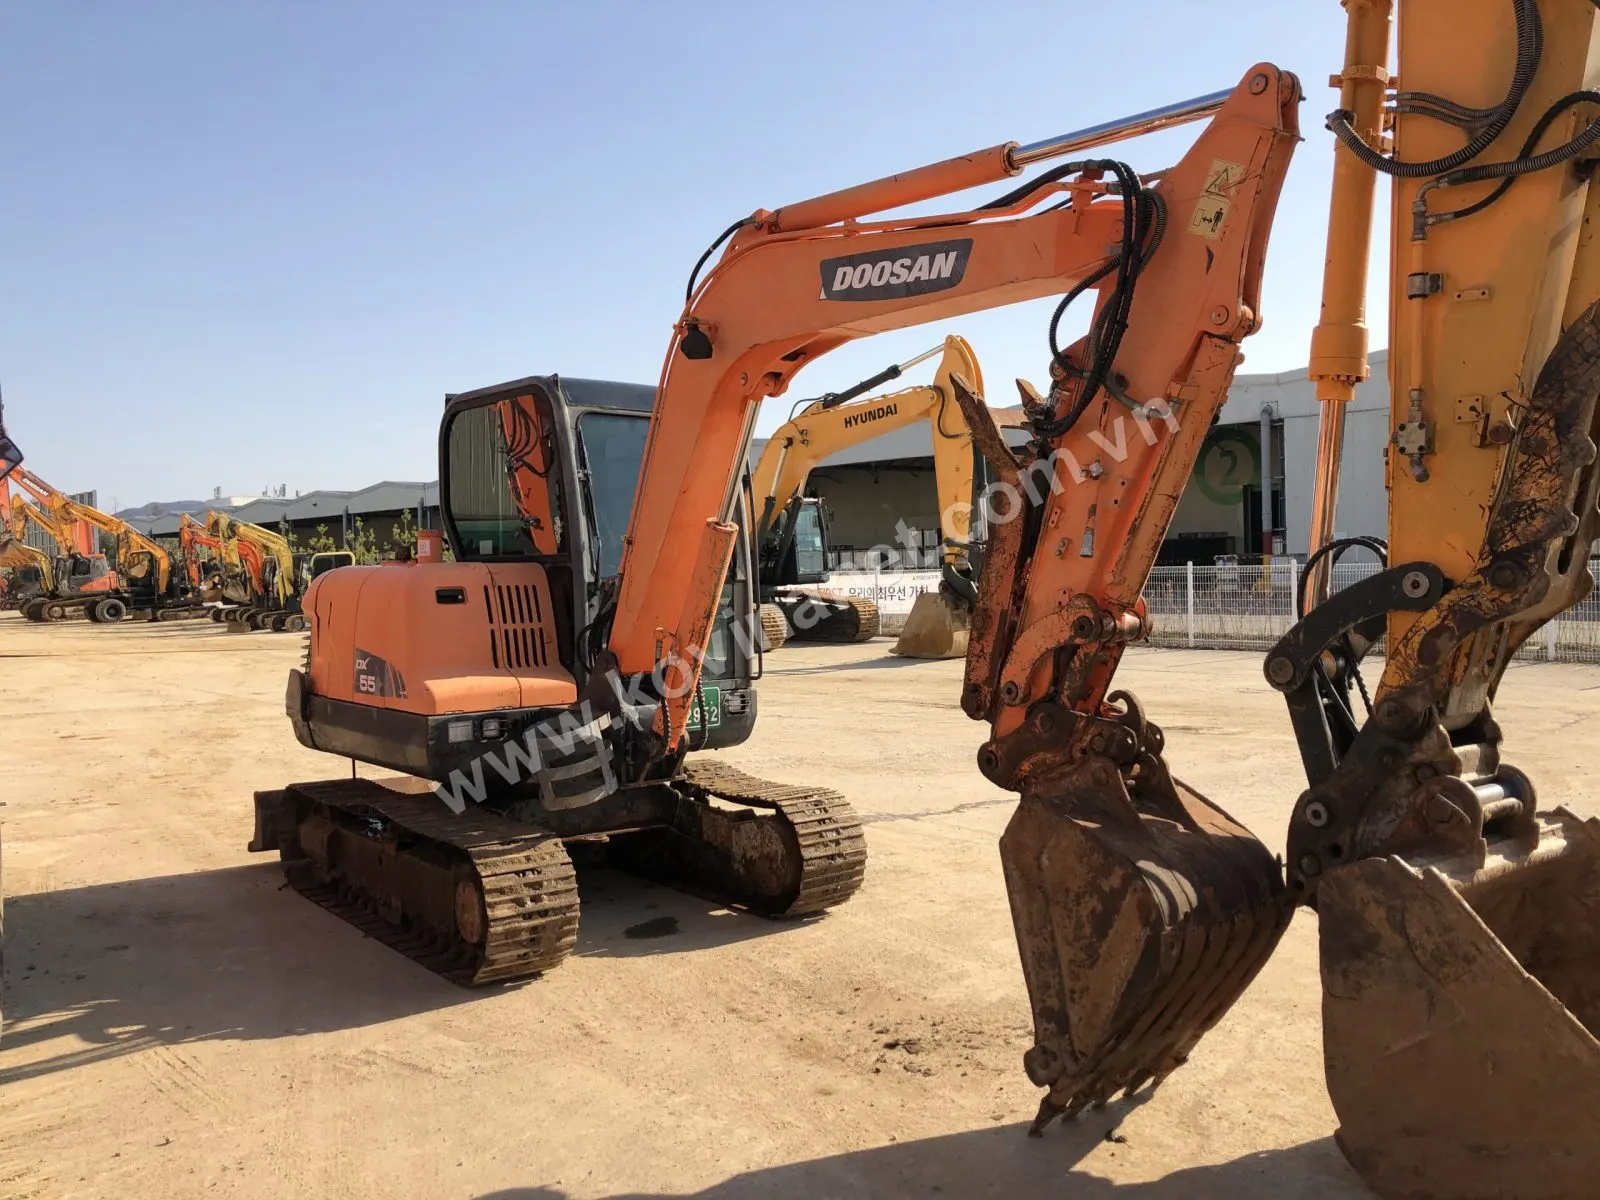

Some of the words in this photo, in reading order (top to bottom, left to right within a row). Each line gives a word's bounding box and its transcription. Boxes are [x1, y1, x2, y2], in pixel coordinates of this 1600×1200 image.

[832, 251, 957, 291] DOOSAN
[844, 403, 898, 428] HYUNDAI
[1219, 449, 1239, 486] 2
[22, 478, 48, 496] DOOSAN
[877, 586, 906, 601] 최우선
[356, 658, 370, 670] DX
[360, 674, 376, 692] 55
